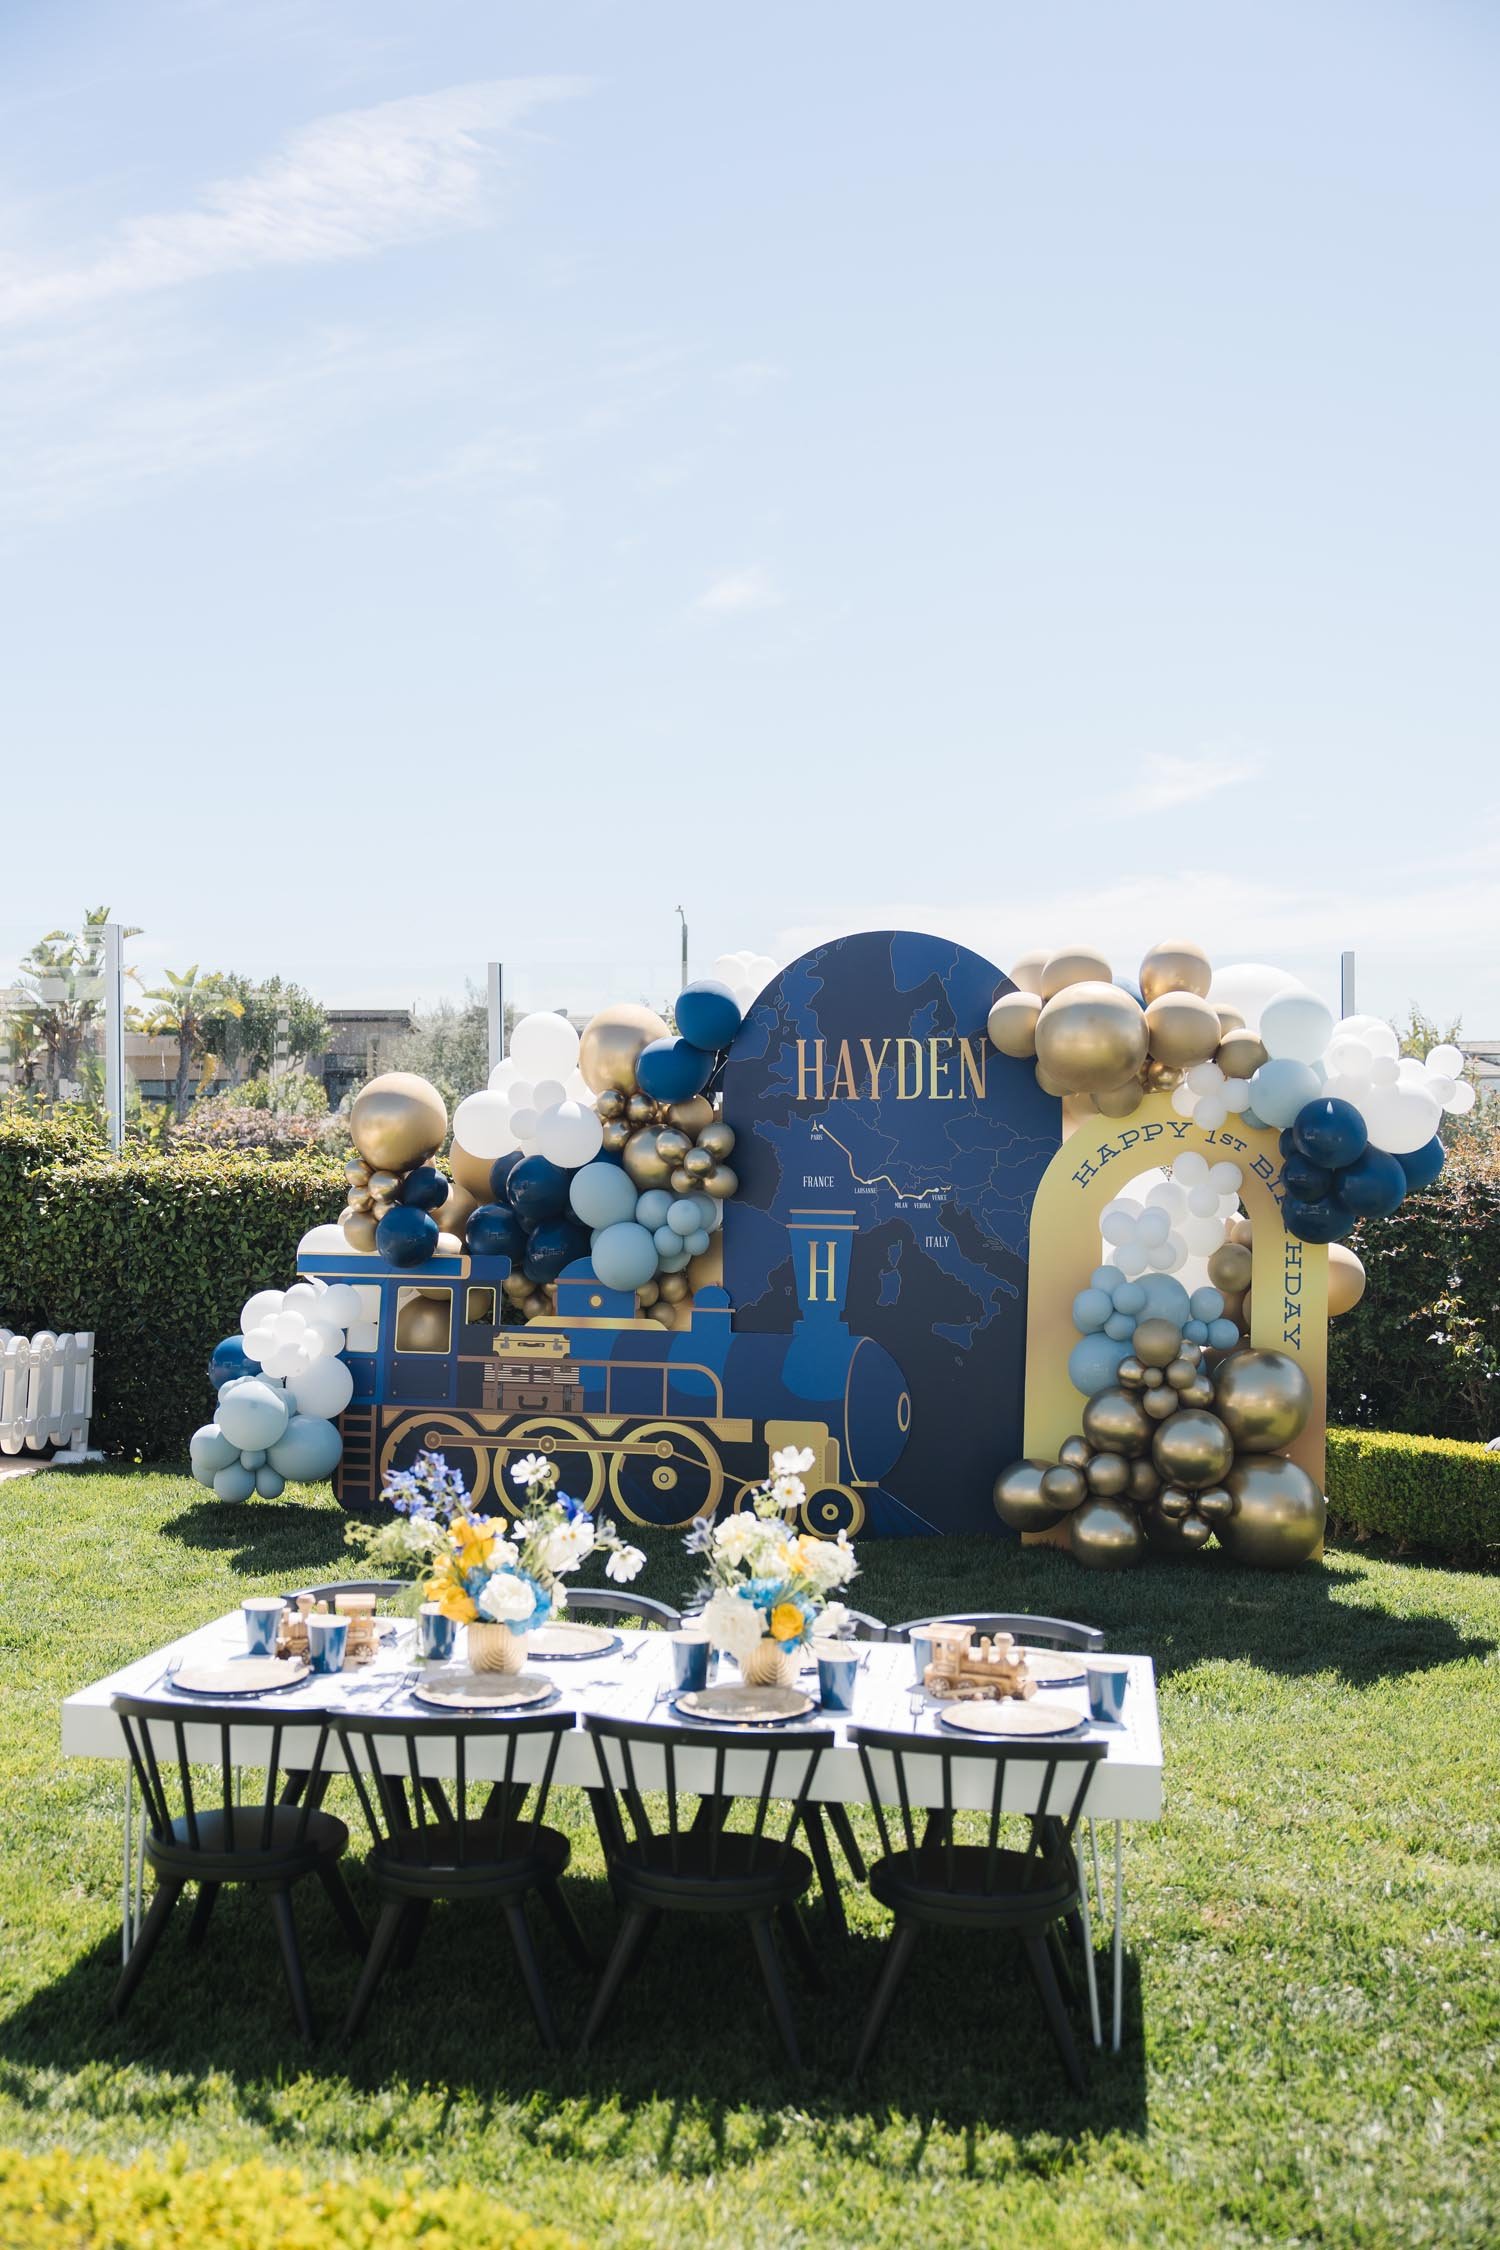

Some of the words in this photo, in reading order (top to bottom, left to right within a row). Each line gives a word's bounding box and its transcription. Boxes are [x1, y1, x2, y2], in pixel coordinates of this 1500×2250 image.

[796, 1037, 987, 1101] HAYDEN
[803, 1176, 835, 1188] FRANCE
[925, 1236, 950, 1248] ITALY
[1072, 1121, 1193, 1188] HAPPY
[1205, 1130, 1247, 1152] 1ST
[1249, 1153, 1302, 1350] BIHDAY
[807, 1241, 837, 1301] H
